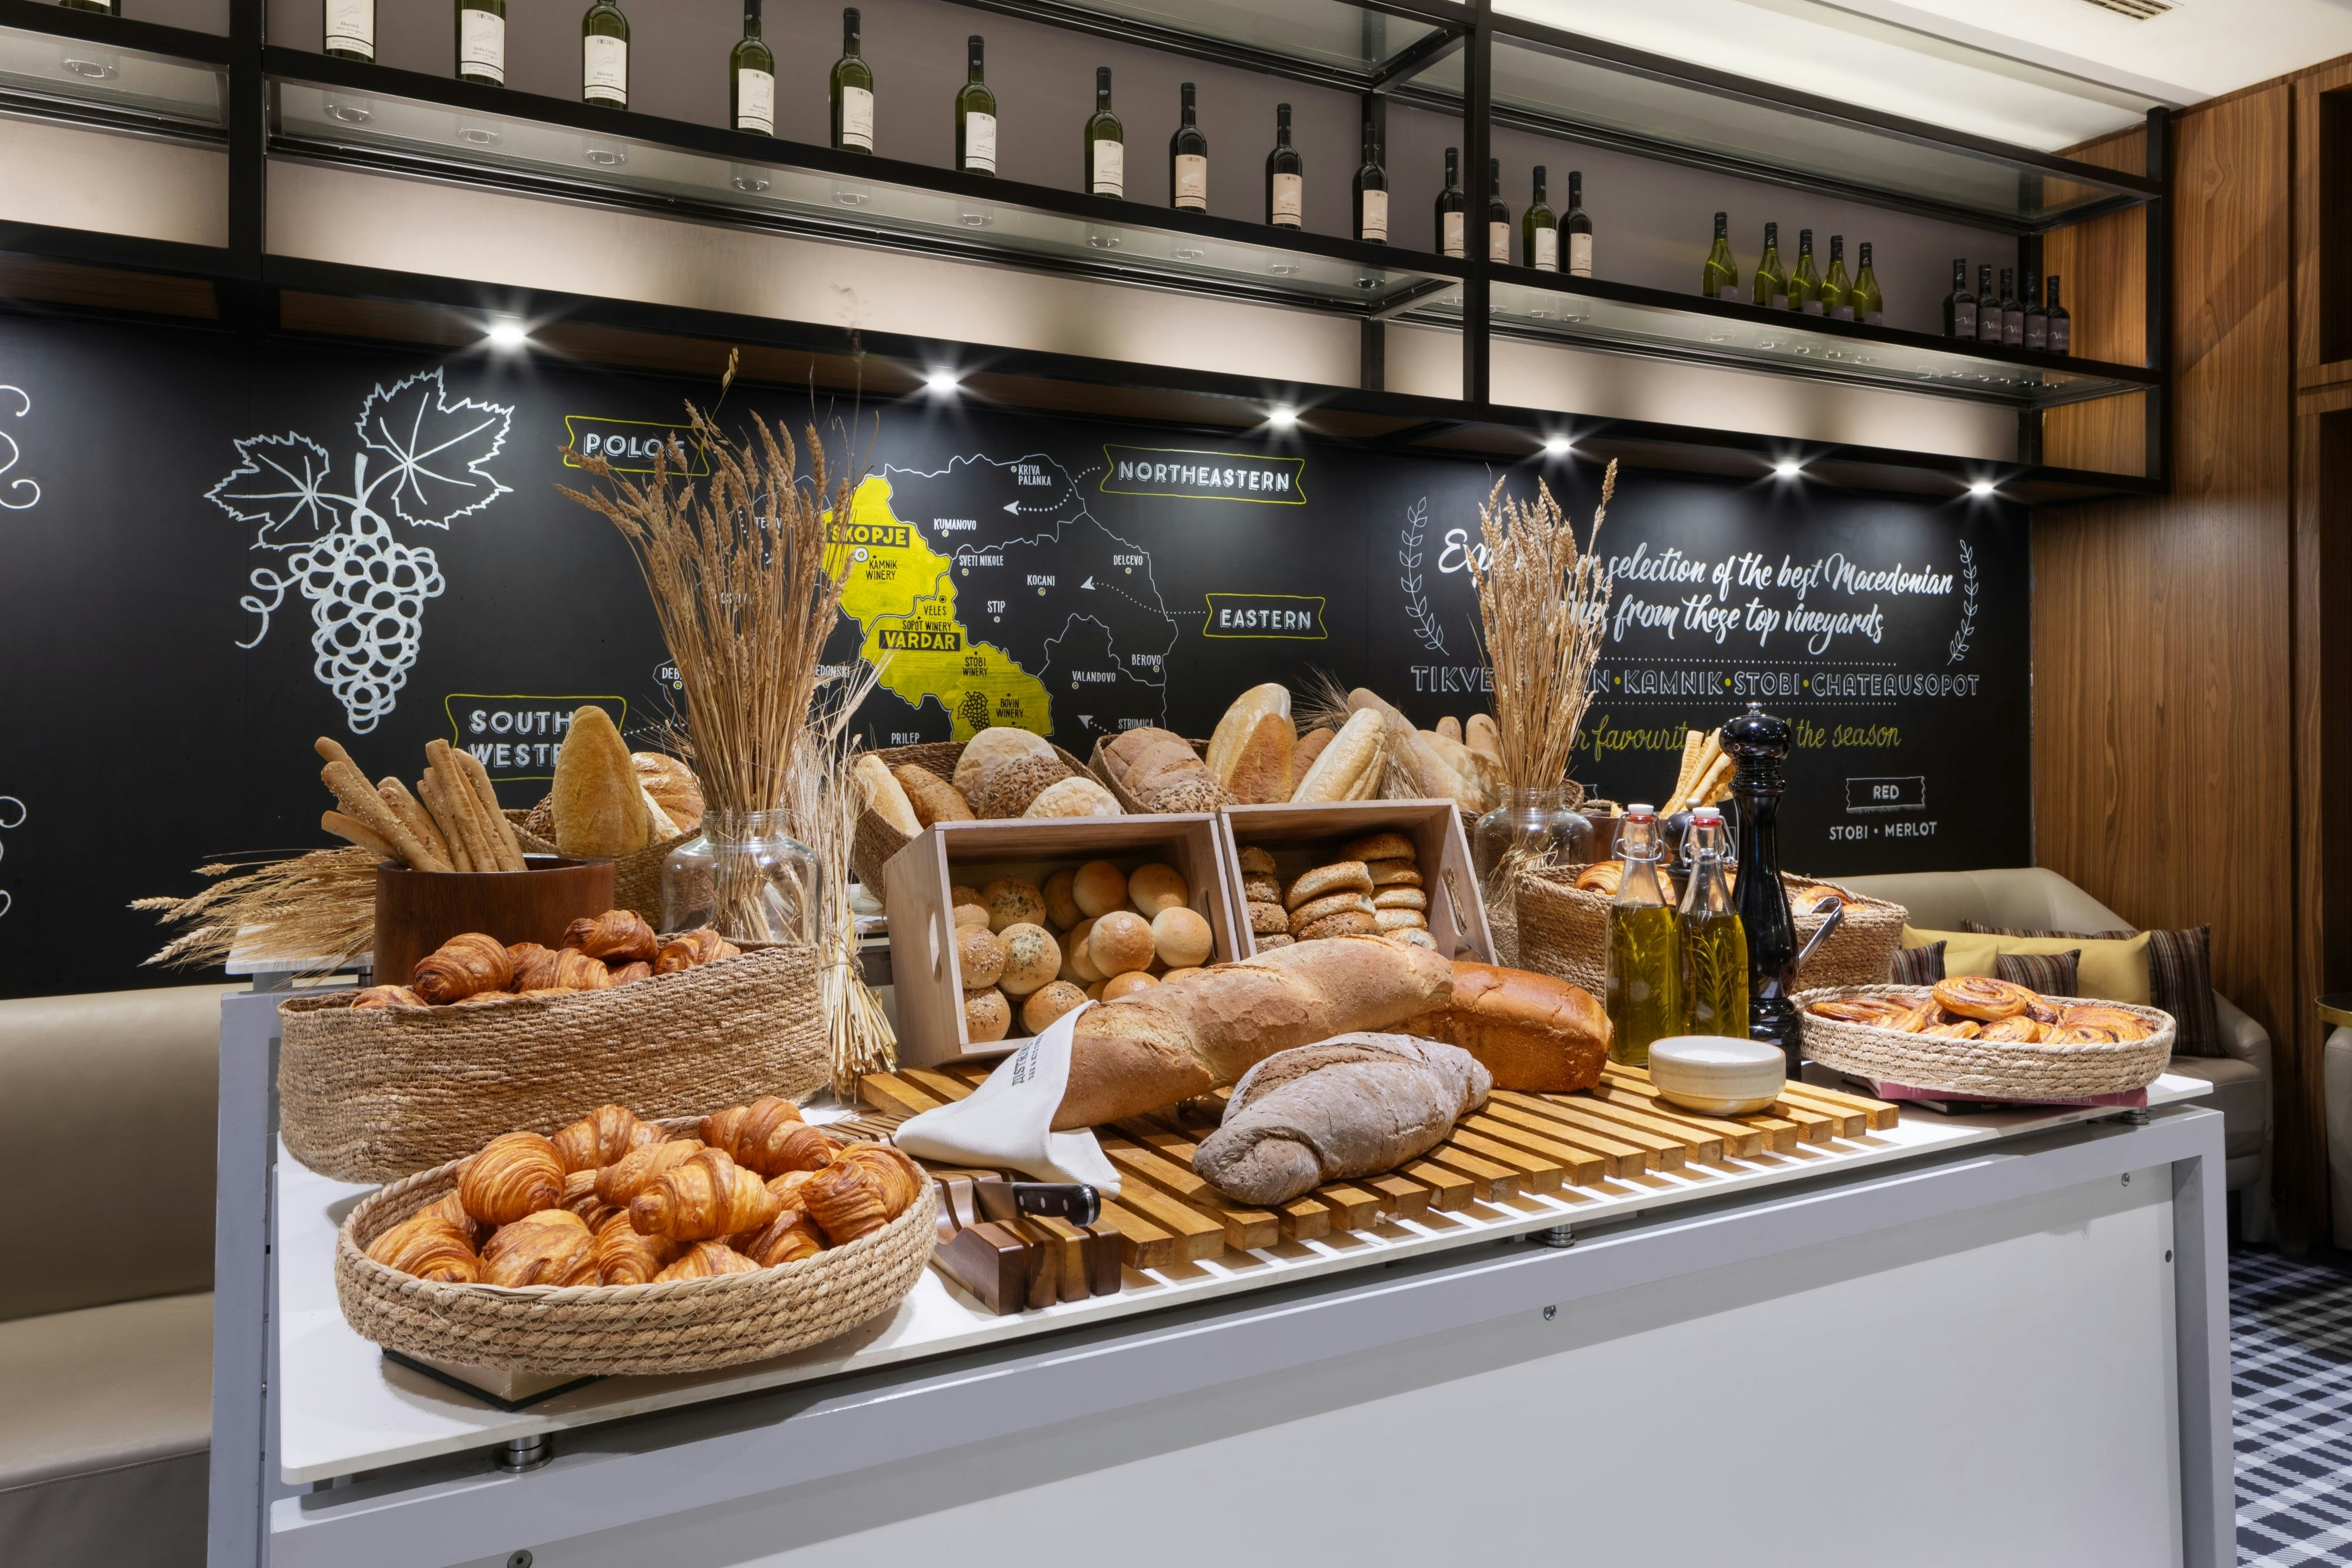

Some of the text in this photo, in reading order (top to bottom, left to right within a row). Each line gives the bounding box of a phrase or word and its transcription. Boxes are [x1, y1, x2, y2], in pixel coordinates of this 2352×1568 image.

[476, 13, 495, 22] STOBI
[753, 72, 768, 81] STOBI
[1018, 464, 1040, 475] KRIVA
[1119, 460, 1289, 491] NORTHEASTERN
[1018, 476, 1051, 486] PALANKA
[934, 518, 977, 530] KUMANOVO
[831, 525, 907, 546] SKOPJE
[869, 560, 898, 570] KAMNIK
[959, 554, 1004, 567] SVETI NIKOLE
[1113, 555, 1143, 566] DELCEVO
[866, 570, 896, 580] WINERY
[1602, 541, 1706, 591] selection
[1712, 554, 1737, 601] of
[1738, 552, 1772, 590] the
[1777, 554, 1823, 600] best
[1824, 552, 1953, 595] Macedonian
[1027, 574, 1055, 586] KOCANI
[924, 606, 946, 616] VELES
[987, 600, 1005, 613] STIP
[1220, 609, 1311, 630] EASTERN
[1613, 594, 1679, 642] from
[1682, 593, 1741, 644] these
[1746, 597, 1780, 647] top
[1785, 603, 1884, 655] vineyards
[903, 620, 951, 632] SOPOT WINERY
[885, 631, 956, 650] VARDAR
[965, 657, 985, 667] STOBI
[1132, 654, 1161, 666] BEROVO
[963, 668, 988, 677] WINERY
[1072, 671, 1116, 683] VALANDOVO
[1411, 666, 1494, 692] TIKVE
[1625, 670, 1723, 695] KAMNIK
[1734, 671, 1799, 696] STOBI
[1000, 698, 1020, 708] BOVIN
[996, 708, 1024, 718] WINERY
[1118, 718, 1154, 730] STRUMICA
[891, 733, 920, 744] PRILEP
[1592, 714, 1688, 763] favourit
[1796, 718, 1826, 748] the
[1832, 723, 1901, 748] season
[1873, 785, 1900, 800] RED
[1829, 821, 1937, 841] STOBI MERLOT
